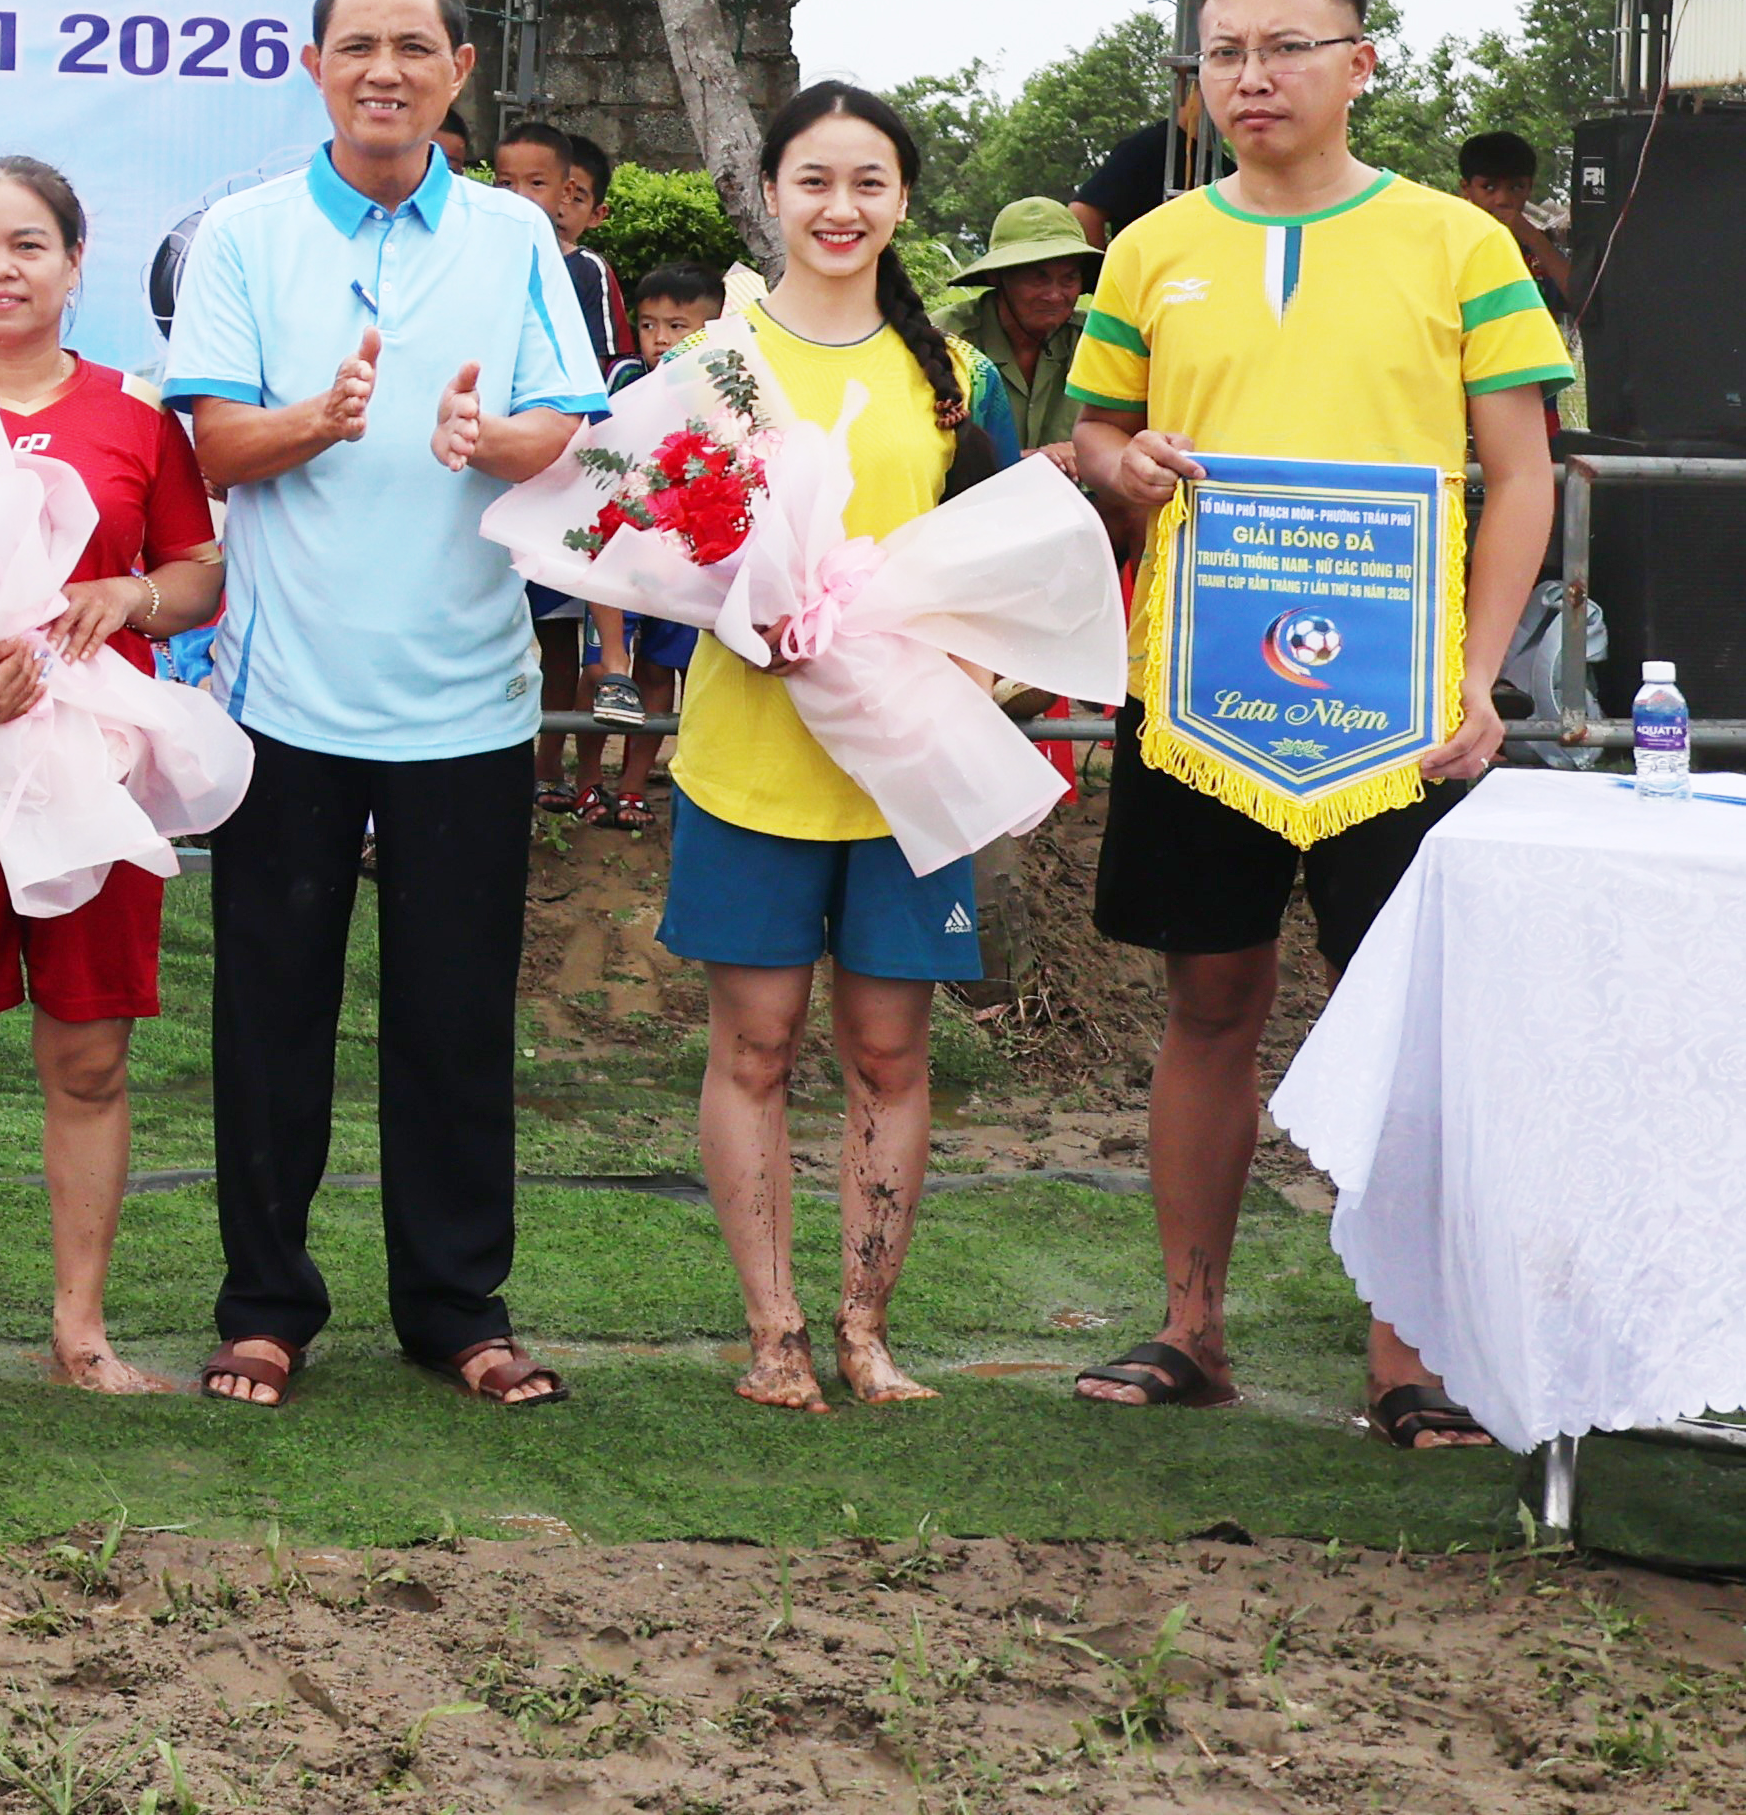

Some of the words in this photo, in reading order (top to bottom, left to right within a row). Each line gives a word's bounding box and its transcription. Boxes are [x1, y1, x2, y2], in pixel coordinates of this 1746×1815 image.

[59, 14, 289, 79] 2026
[1233, 522, 1275, 545] GIẢI
[1281, 526, 1339, 550] BÓNG
[1345, 530, 1375, 552] ĐÁ
[1212, 689, 1277, 722] Lưu
[1284, 698, 1389, 733] Niệm
[1637, 725, 1683, 736] AQUATTA
